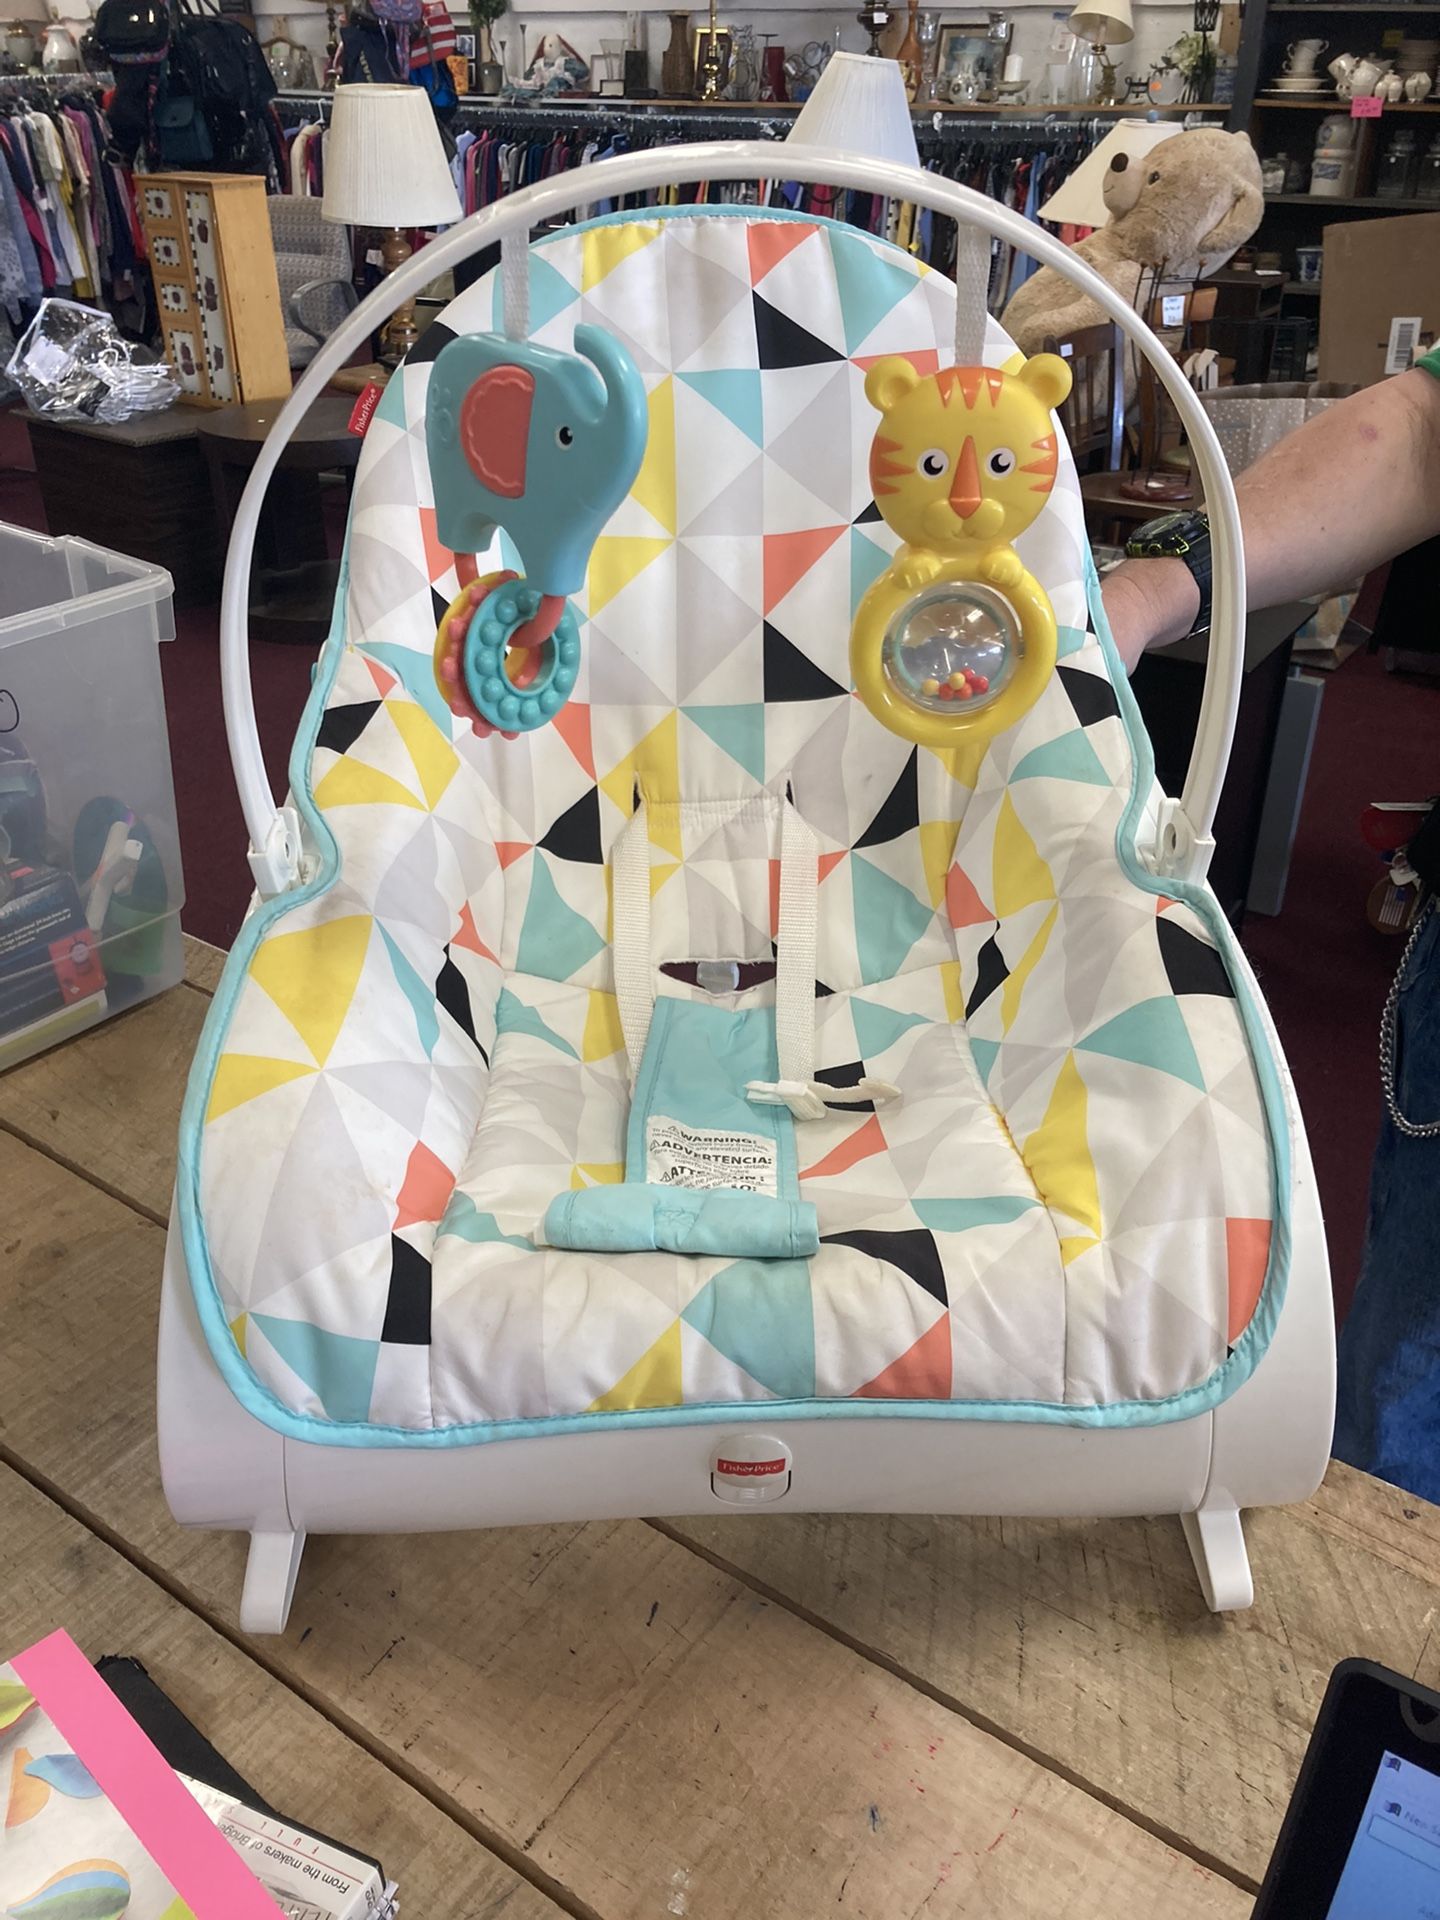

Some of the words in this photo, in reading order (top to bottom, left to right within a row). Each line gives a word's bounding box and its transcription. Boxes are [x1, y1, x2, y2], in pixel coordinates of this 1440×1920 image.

[248, 1840, 264, 1851] of
[263, 1845, 304, 1870] makers
[302, 1863, 322, 1881] the
[321, 1872, 351, 1895] From
